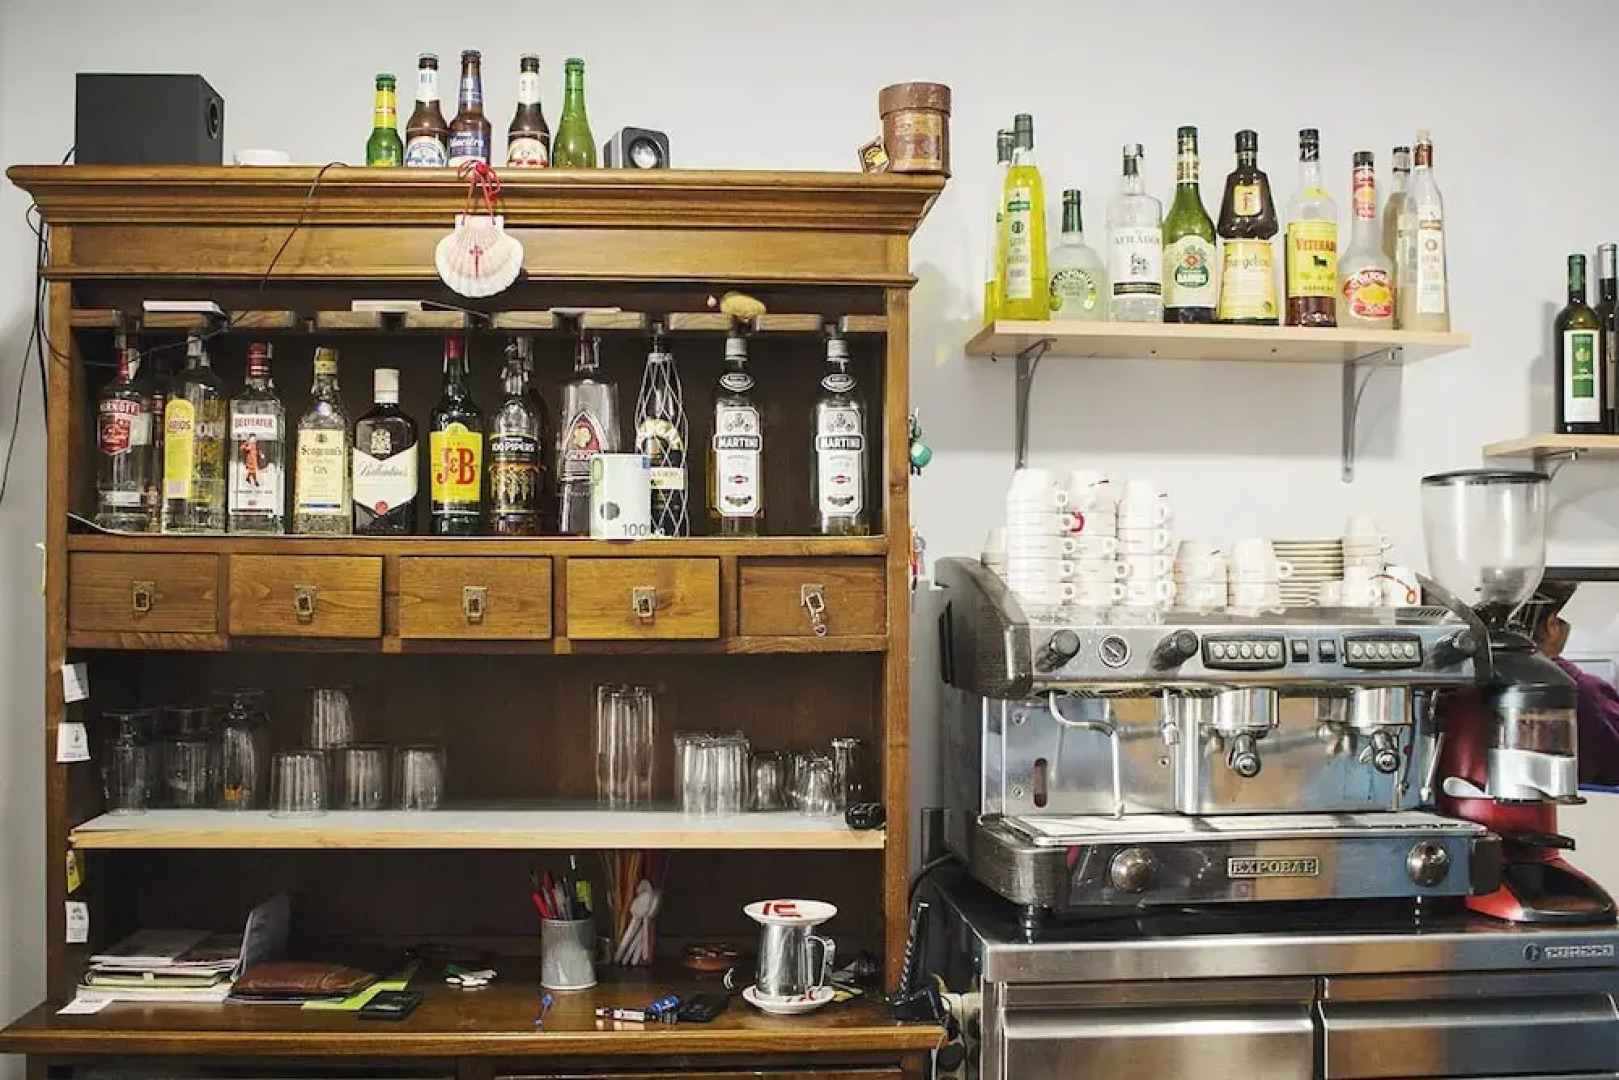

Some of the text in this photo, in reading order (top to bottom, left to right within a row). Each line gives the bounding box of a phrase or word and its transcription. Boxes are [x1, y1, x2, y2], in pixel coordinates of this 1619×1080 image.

[720, 437, 760, 449] MARTINI
[820, 437, 861, 449] MARTINI
[437, 447, 476, 485] J&B
[1232, 860, 1316, 874] EXPOBAR
